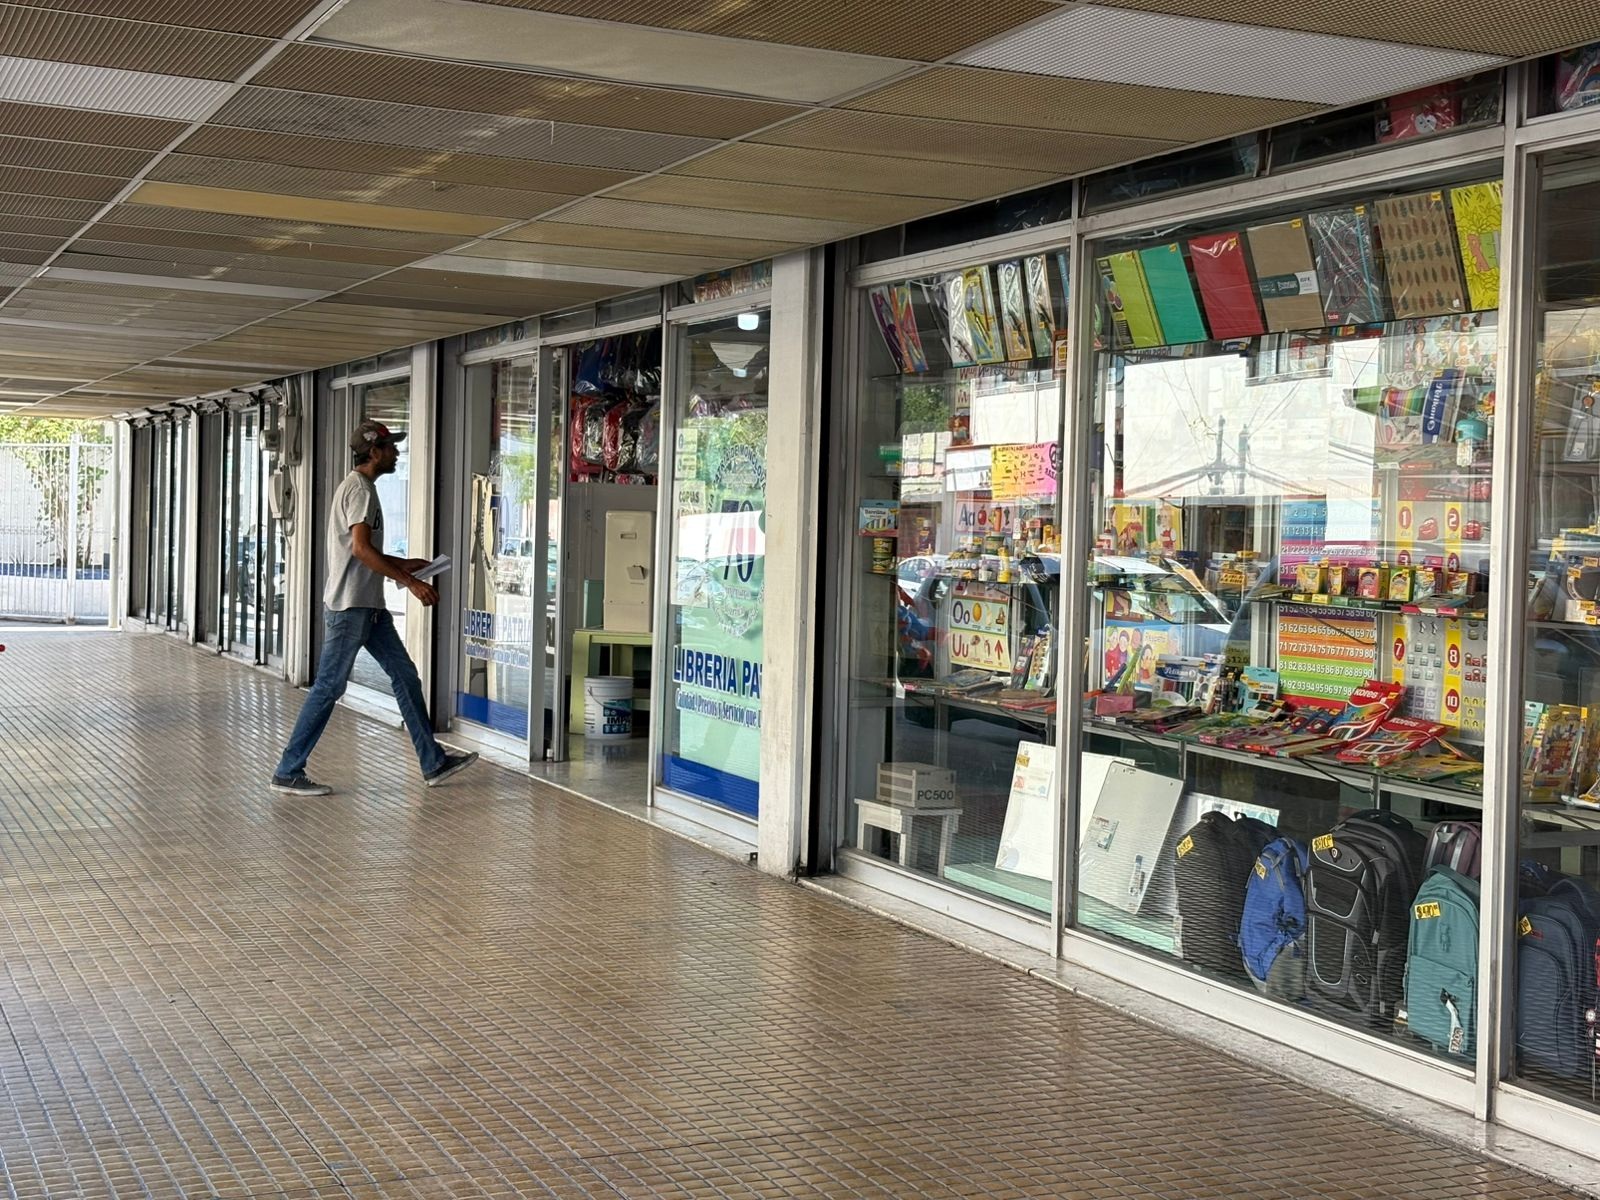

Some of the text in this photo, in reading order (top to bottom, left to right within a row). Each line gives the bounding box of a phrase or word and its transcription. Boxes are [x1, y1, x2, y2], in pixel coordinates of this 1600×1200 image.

[1402, 511, 1407, 526] 1
[1449, 513, 1457, 527] 2
[953, 601, 970, 624] Oo
[1288, 623, 1298, 633] 62
[1298, 624, 1307, 634] 63
[1308, 624, 1317, 634] 64
[1317, 625, 1326, 635] 65
[1355, 628, 1364, 637] 69
[953, 634, 969, 657] Uu
[1279, 641, 1374, 658] 71 72 73 74 75 76 77 78 79 80
[1395, 643, 1402, 656] 7
[1449, 649, 1458, 663] 8
[673, 646, 737, 693] LIBRERIA
[1288, 661, 1297, 670] 82
[1298, 662, 1307, 671] 83
[1306, 663, 1316, 672] 84
[1316, 664, 1325, 673] 85
[1325, 664, 1334, 673] 86
[1335, 665, 1344, 674] 87
[1353, 667, 1363, 677] 89
[1363, 668, 1373, 678] 90
[1287, 680, 1297, 689] 92
[1297, 681, 1306, 690] 93
[1306, 682, 1315, 691] 94
[1315, 683, 1324, 692] 95
[1324, 684, 1333, 693] 96
[1333, 685, 1342, 694] 97
[1343, 686, 1352, 696] 98
[1447, 696, 1459, 708] 10
[917, 790, 954, 800] PC500
